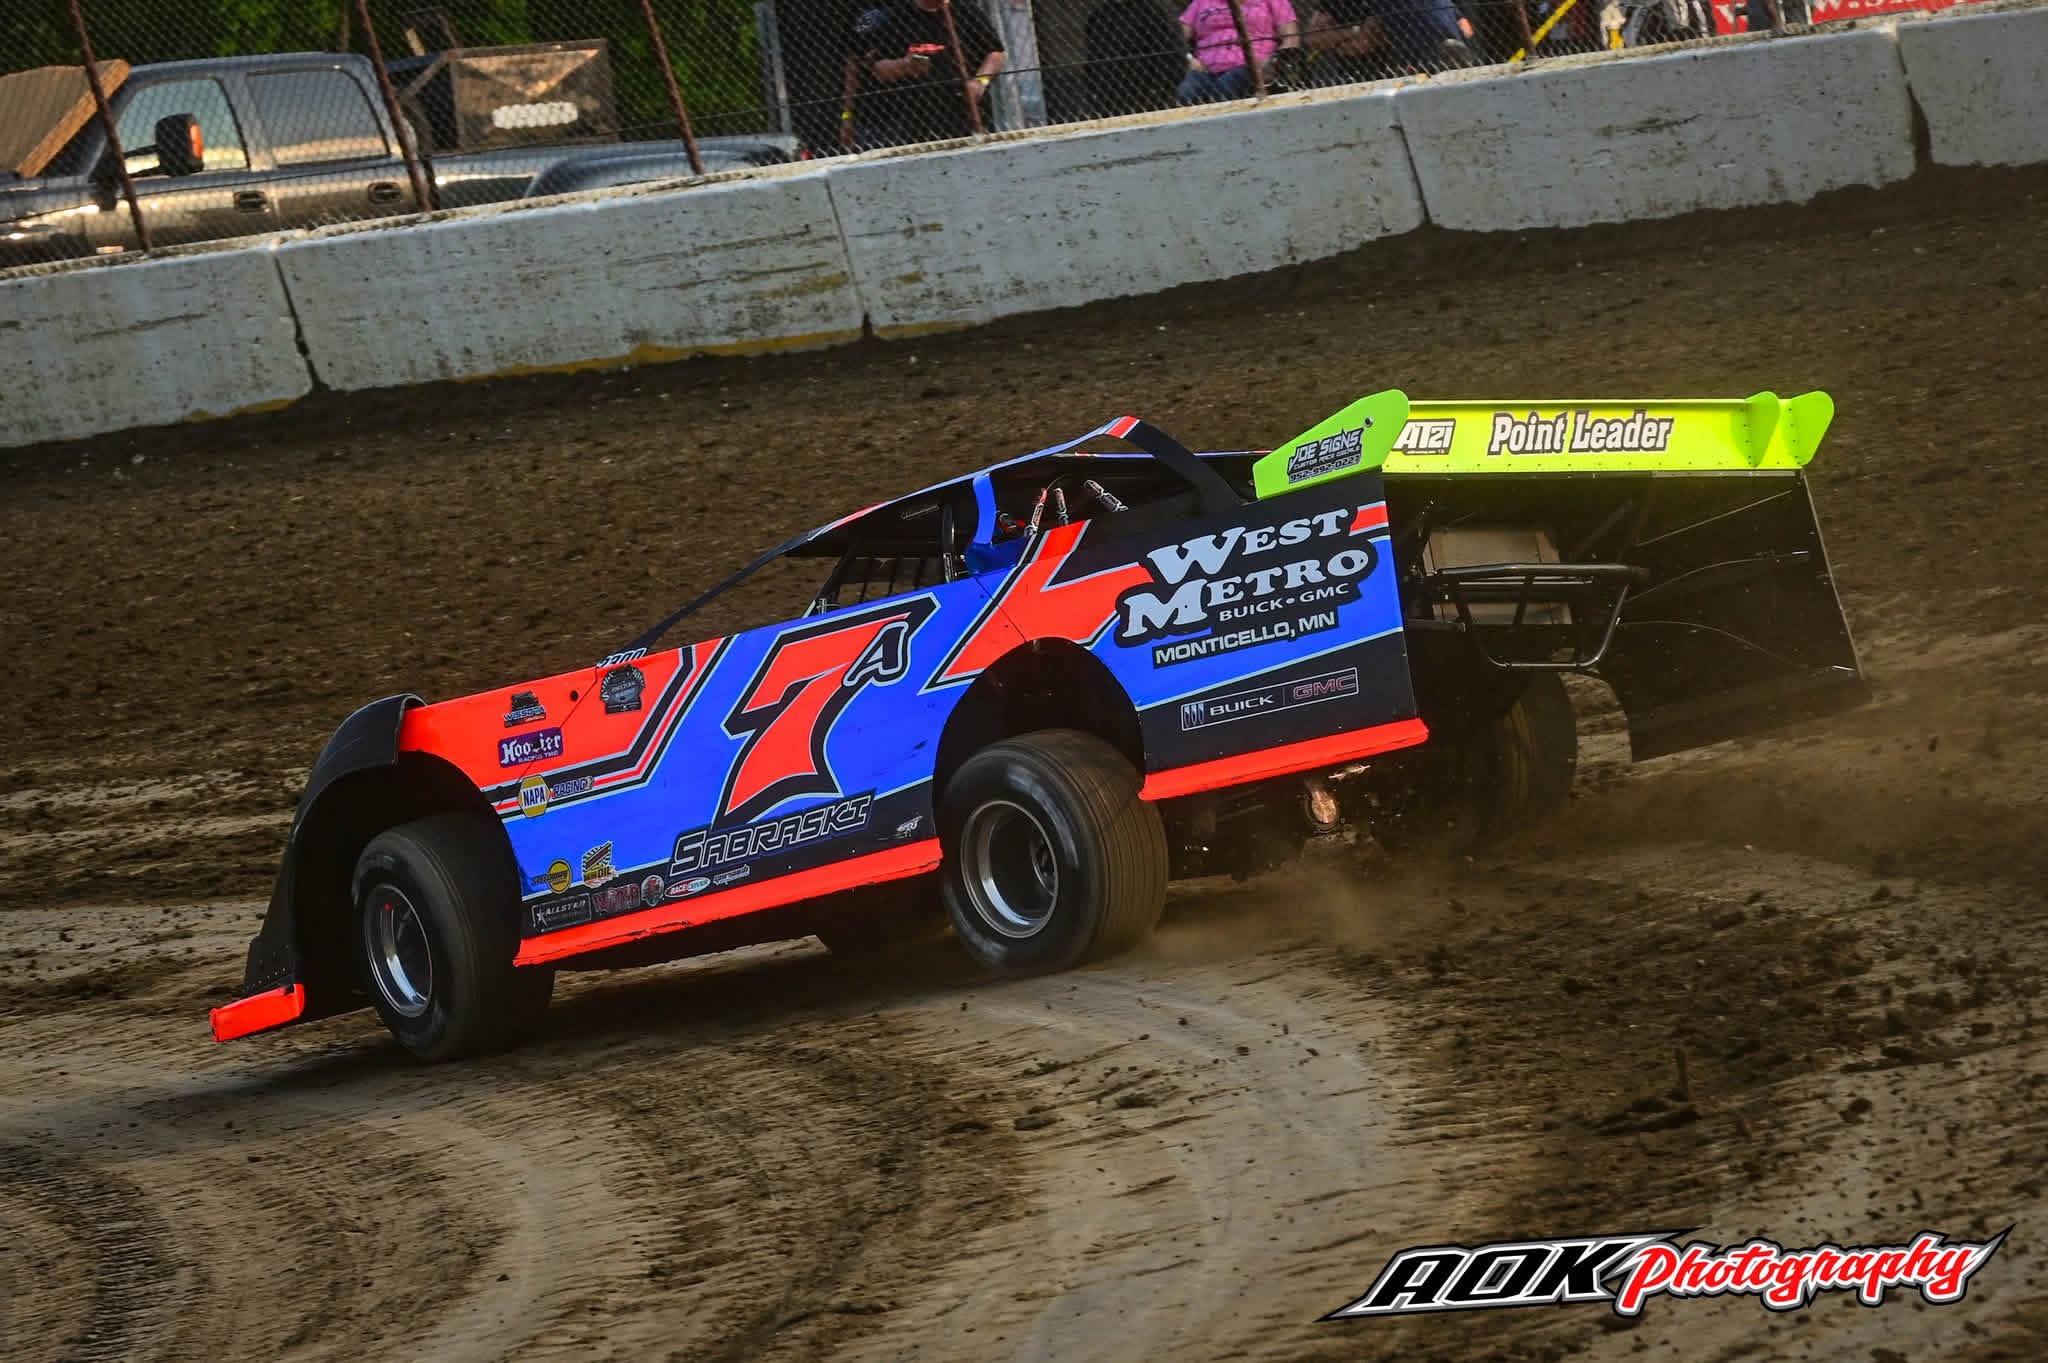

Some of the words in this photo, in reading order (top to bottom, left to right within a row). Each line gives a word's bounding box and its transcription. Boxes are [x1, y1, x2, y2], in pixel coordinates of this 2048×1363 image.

[1288, 443, 1318, 472] JOE
[1319, 431, 1362, 457] SIGNS
[1488, 412, 1567, 454] Point
[1569, 410, 1674, 452] Leader
[1147, 508, 1349, 585] WEST
[1122, 549, 1369, 638] METRO
[1154, 620, 1296, 666] MONTICELLO,
[1298, 611, 1336, 634] MN
[1209, 694, 1274, 718] BUICK
[1292, 673, 1356, 700] GMC
[523, 786, 545, 807] NAPA
[552, 778, 587, 798] RACING
[670, 795, 872, 877] SABRASKI
